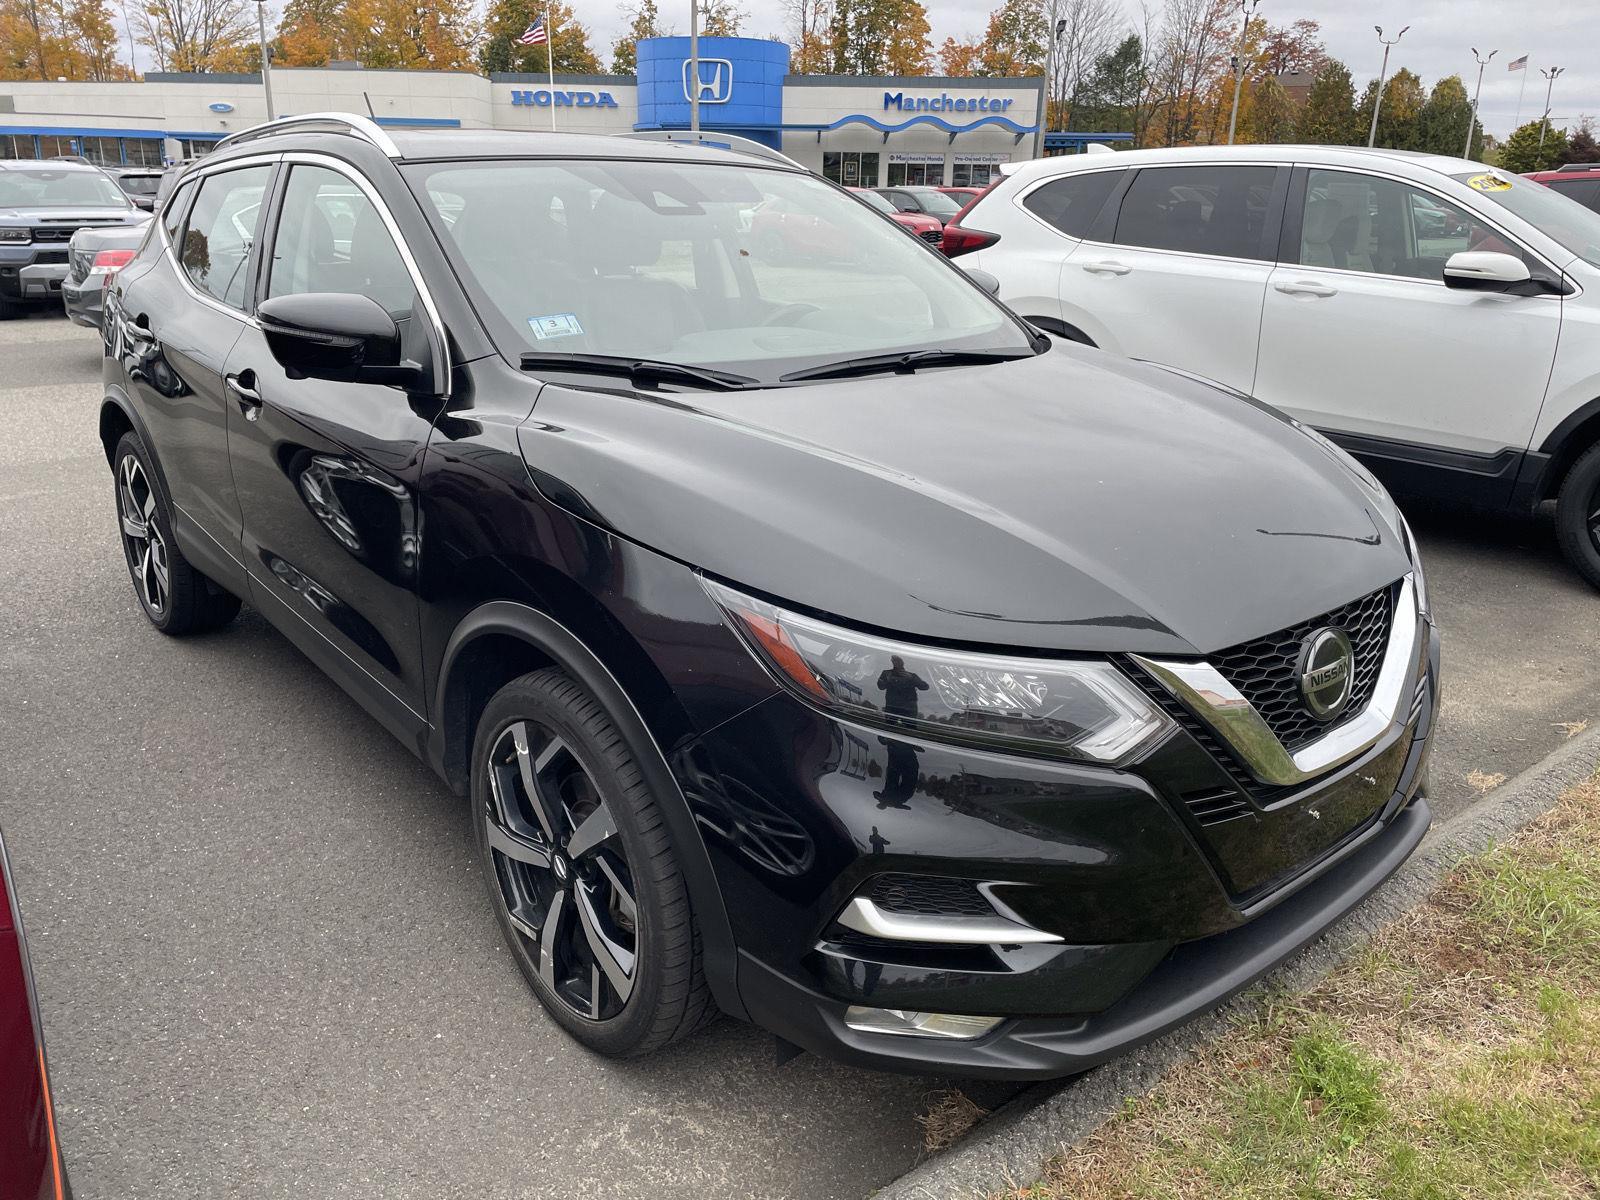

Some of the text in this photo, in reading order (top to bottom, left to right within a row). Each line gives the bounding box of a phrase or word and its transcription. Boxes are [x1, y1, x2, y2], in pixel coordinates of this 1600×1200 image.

[511, 90, 618, 107] HONDA
[884, 92, 1013, 111] Manchester
[549, 320, 558, 328] 3
[1310, 661, 1348, 688] NISSAN
